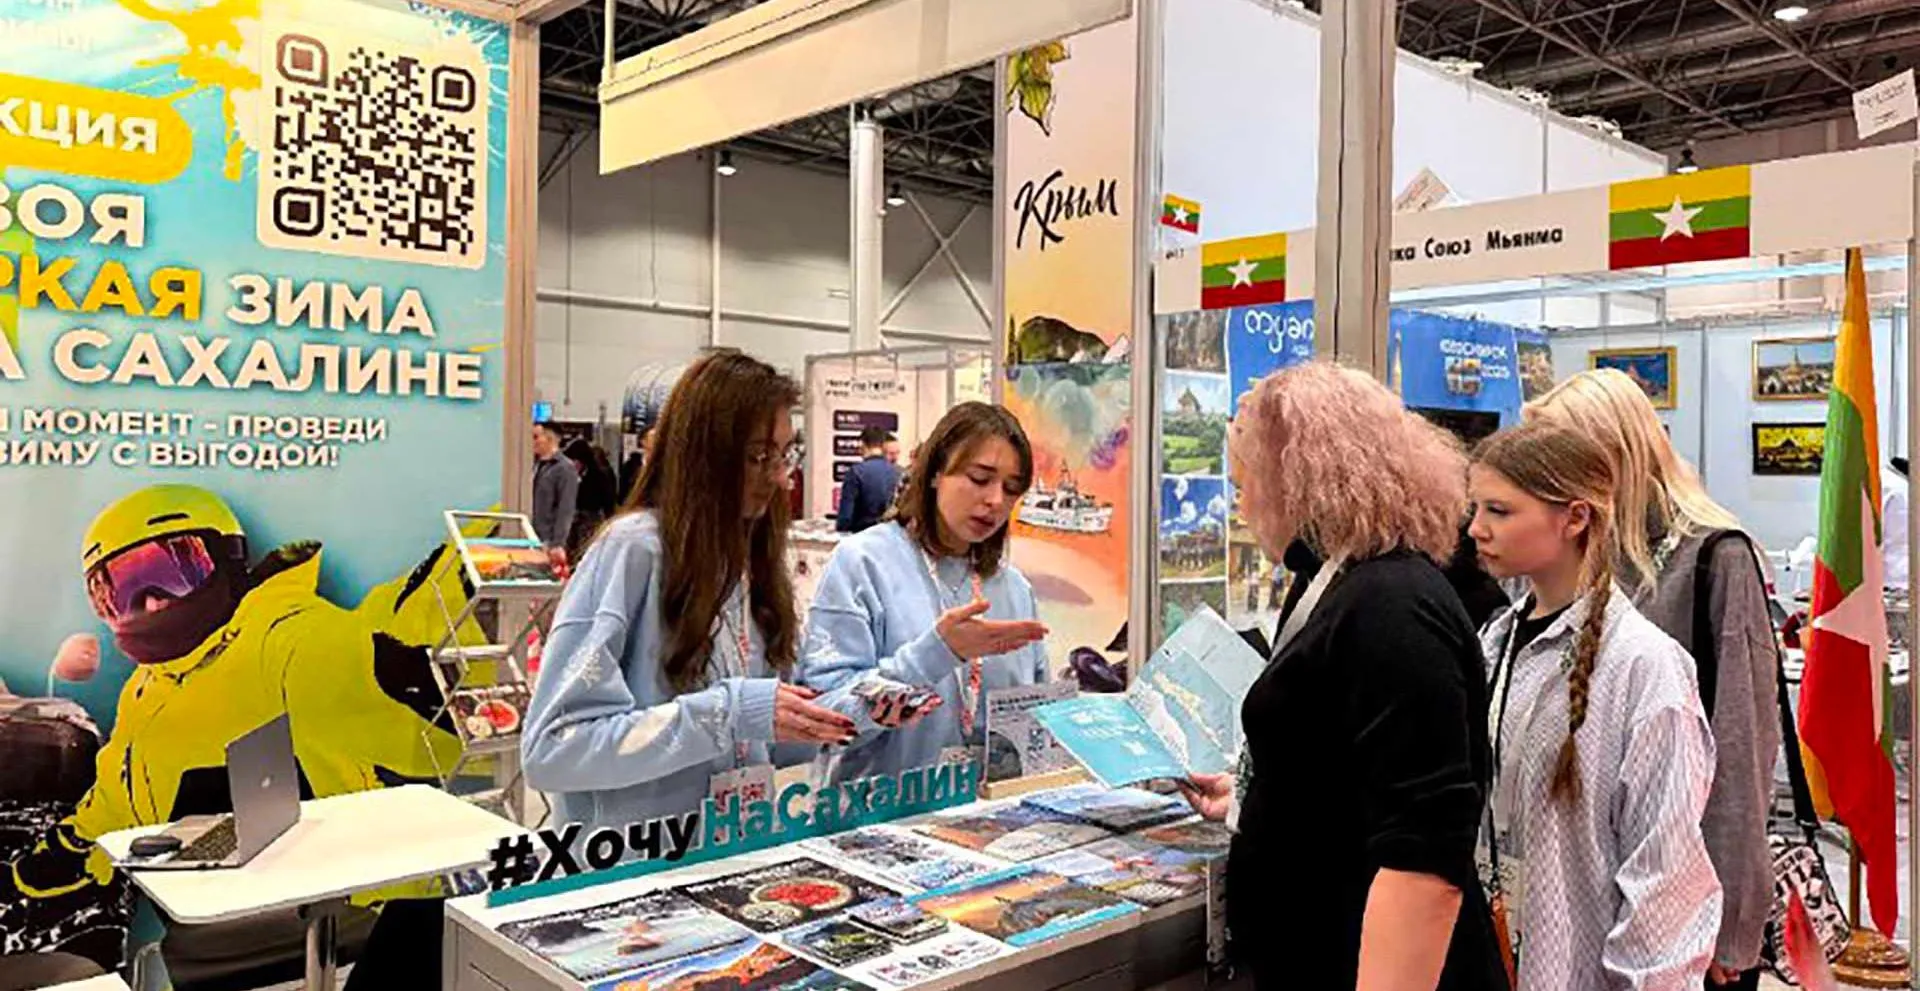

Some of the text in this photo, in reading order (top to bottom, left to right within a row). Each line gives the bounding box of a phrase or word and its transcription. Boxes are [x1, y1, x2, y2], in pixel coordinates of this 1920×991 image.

[0, 182, 145, 247] ОЯ
[1014, 169, 1119, 251] Крым
[1424, 237, 1472, 258] Союз
[1486, 227, 1563, 251] Мьянма
[227, 275, 437, 337] ЗИМА
[53, 329, 483, 400] САХАЛИНЕ
[23, 408, 193, 437] МОМЕНТ
[227, 415, 387, 443] ПРОВЕДИ
[112, 442, 137, 466] С
[150, 438, 339, 470] ВЫГОДОЙ!
